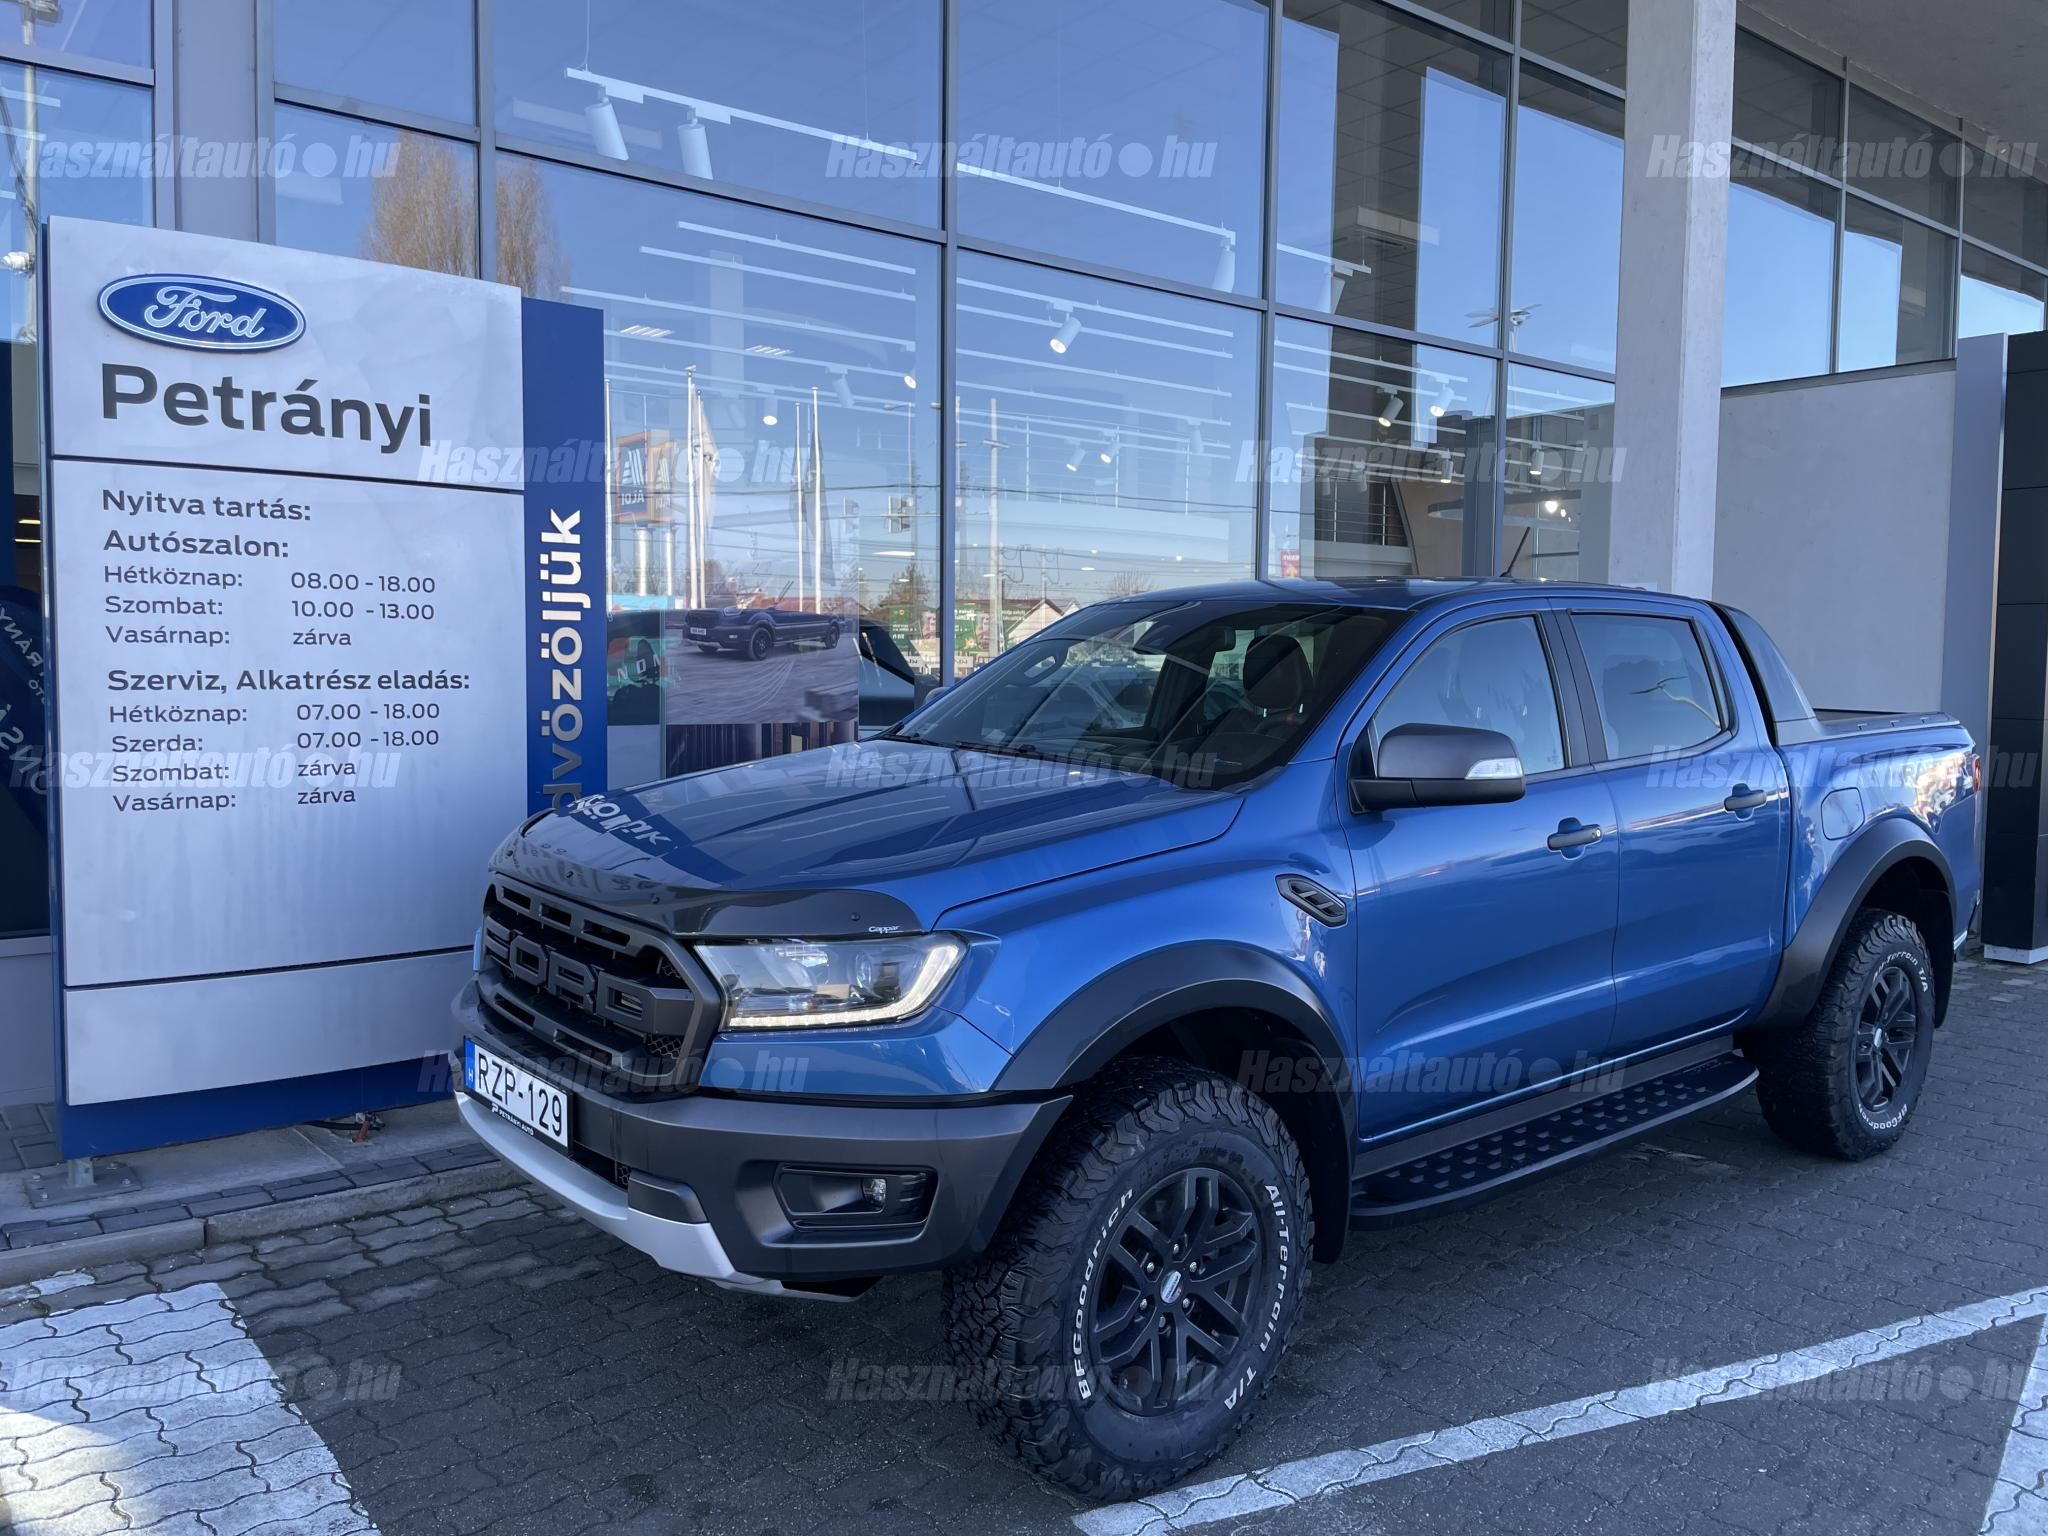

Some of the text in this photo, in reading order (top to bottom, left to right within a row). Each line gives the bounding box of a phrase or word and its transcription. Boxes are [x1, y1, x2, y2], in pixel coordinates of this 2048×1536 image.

[145, 285, 266, 338] Ford
[102, 363, 432, 454] Petrányi
[103, 490, 311, 521] Nyitva tartás:
[103, 530, 289, 558] Autószalon:
[104, 565, 243, 590] Hétköznap:
[104, 595, 223, 616] Szombat:
[291, 601, 354, 618] 10.00
[105, 624, 352, 648] Vasárnap: zárva
[107, 669, 470, 695] Szerviz, Alkatrész eladás:
[109, 705, 248, 726] Hétköznap:
[111, 734, 203, 754] Szerda:
[112, 760, 357, 783] Szombat: zárva
[113, 787, 356, 812] Vasárnap: zárva
[478, 1053, 562, 1137] RZP-129
[1073, 1188, 1133, 1400] BFGoodrich
[1224, 1185, 1290, 1410] All-Terrain T/A
